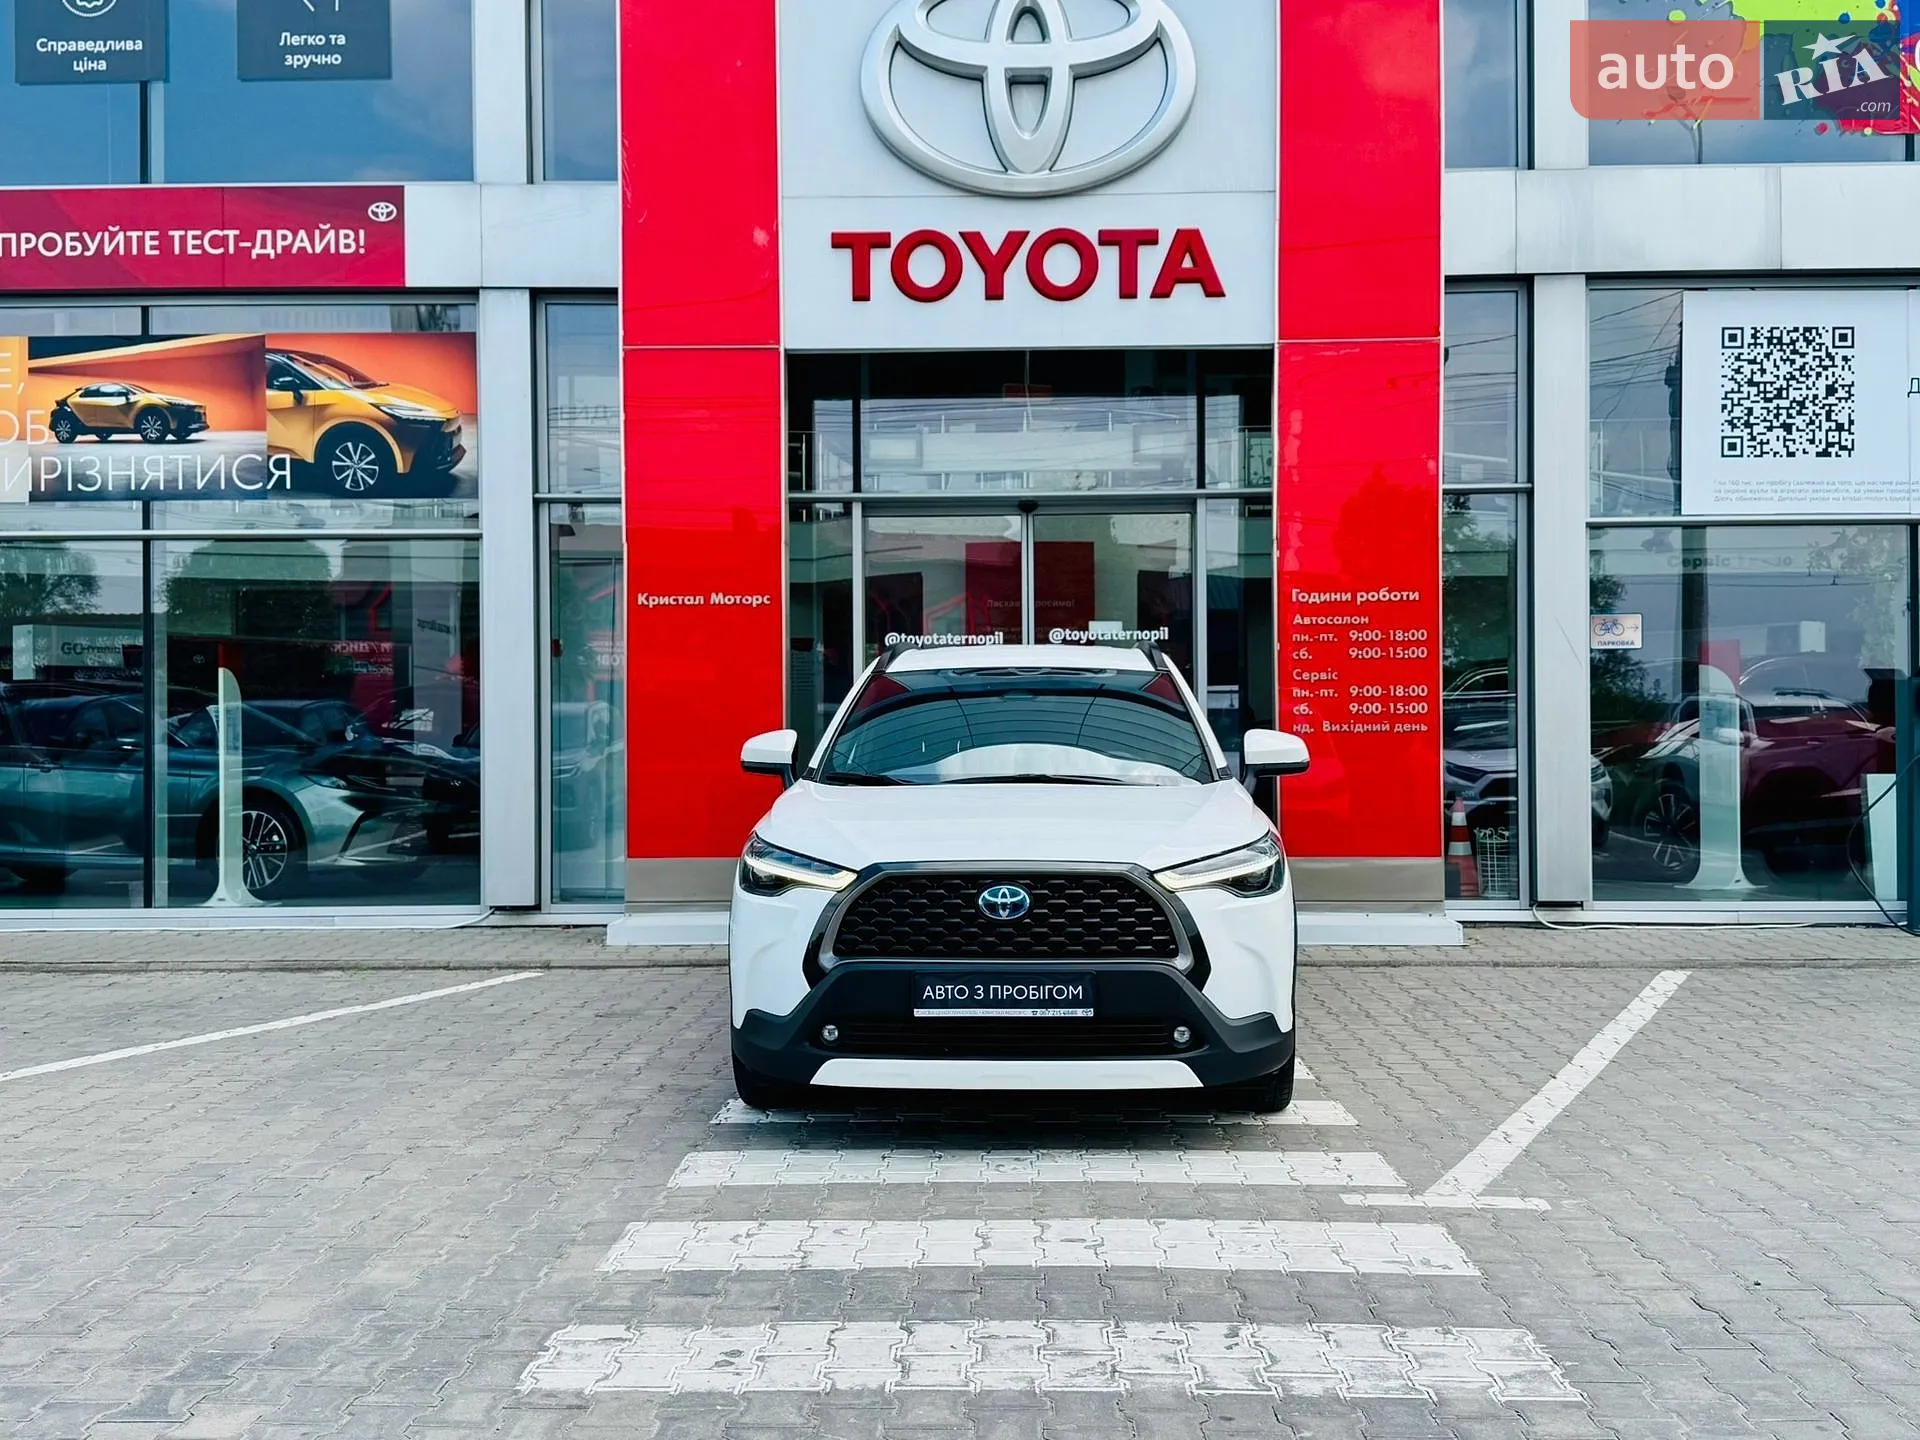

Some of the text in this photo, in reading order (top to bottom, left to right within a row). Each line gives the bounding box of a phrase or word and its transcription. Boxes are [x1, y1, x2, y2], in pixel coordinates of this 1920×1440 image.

[36, 38, 143, 54] Справедлива
[279, 32, 346, 46] Легко та
[73, 57, 107, 73] ціна
[284, 54, 342, 68] зручно
[0, 224, 366, 260] ПРОБУЙТЕ ТЕСТ-ДРАЙВ!
[831, 228, 1226, 303] TOYOTA
[637, 592, 771, 608] Кристал Моторс
[1291, 587, 1420, 605] Години роботи
[1292, 614, 1369, 625] Автосалон
[884, 631, 1003, 647] @toyotaternopil
[1049, 627, 1169, 644] @toyotaternopil
[1292, 629, 1428, 642] пн.-пт. 9:00-18:00
[1292, 647, 1428, 660] сб. 9:00-15:00
[1292, 668, 1339, 682] Сервіс
[1292, 685, 1428, 698] пн.-пт. 9:00-18:00
[1292, 703, 1428, 715] сб. 9:00-15:00
[1292, 720, 1428, 734] нд. Вихідний день
[923, 985, 1083, 1000] АВТО З ПРОБІГОМ
